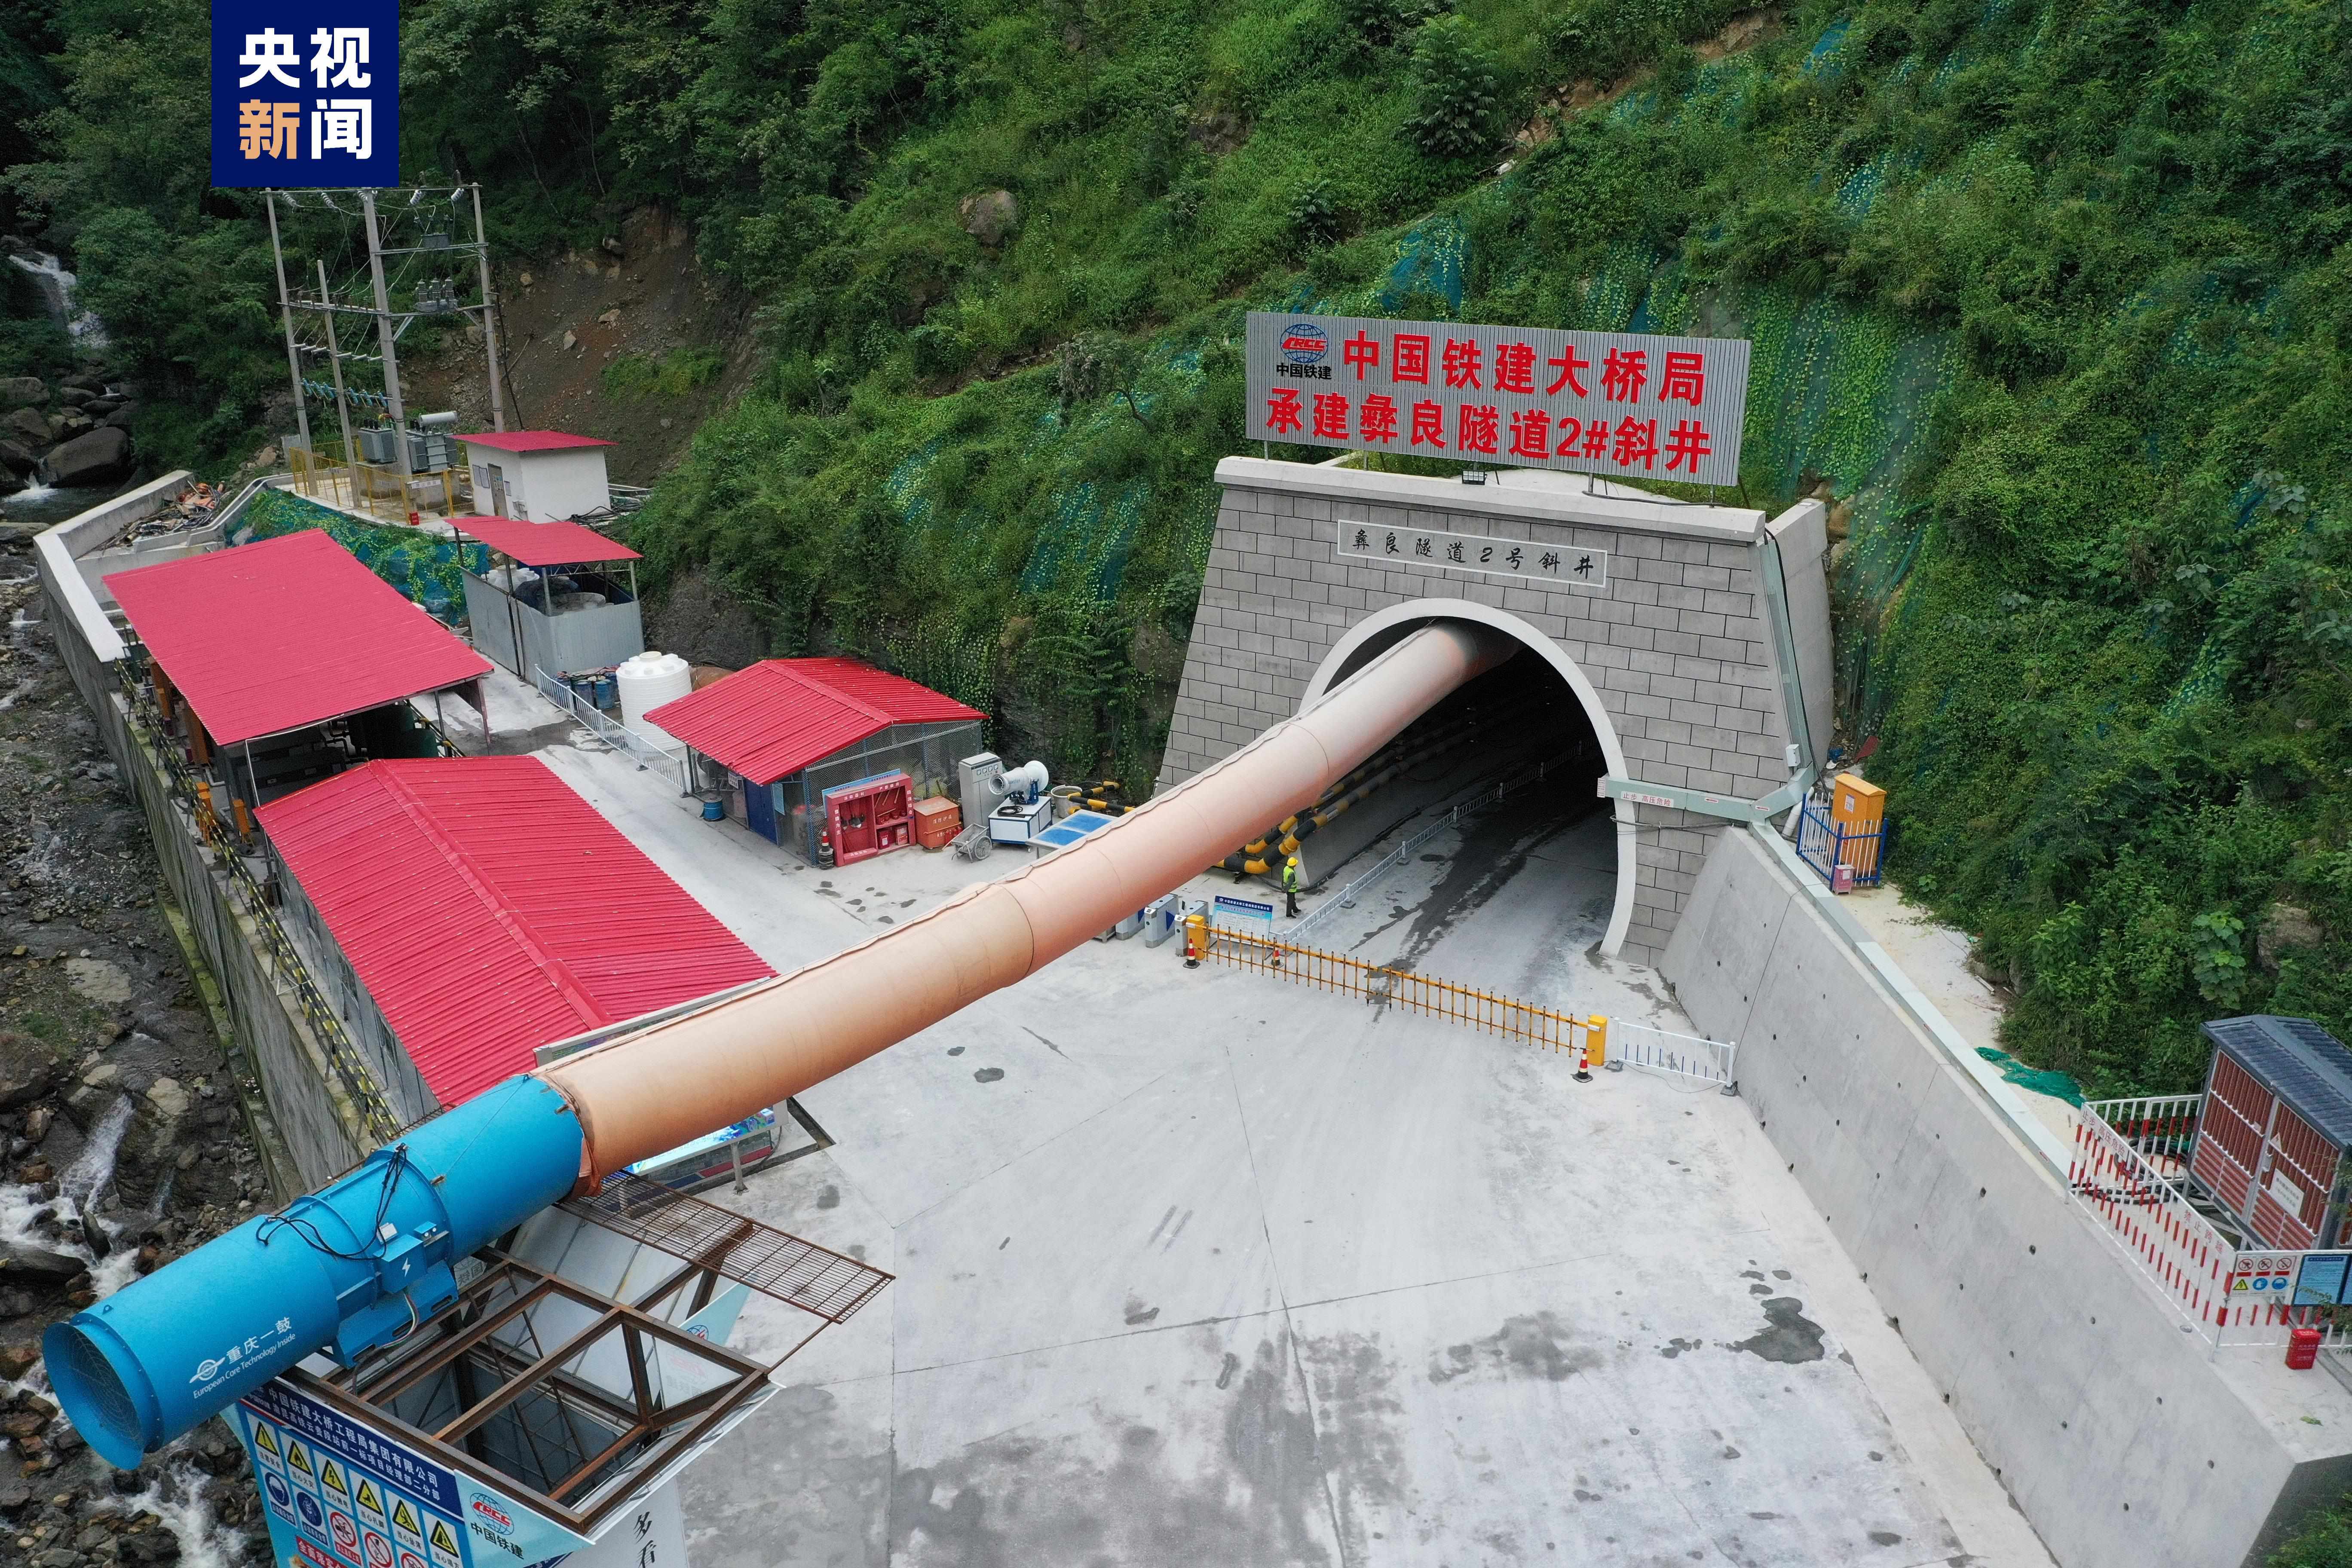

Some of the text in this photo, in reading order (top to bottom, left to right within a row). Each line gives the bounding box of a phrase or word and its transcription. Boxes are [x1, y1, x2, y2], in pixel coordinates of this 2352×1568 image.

[1276, 362, 1332, 380] 中国铁建
[1344, 329, 1704, 407] 中国铁建大桥局
[1267, 387, 1711, 473] 承建彝良隧道2#斜井
[1352, 528, 1593, 579] 彝良隧道2号斜井
[1642, 795, 1671, 806] 高压危险
[2082, 1110, 2096, 1126] 止步
[226, 1317, 292, 1364] 重庆一鼓
[193, 1376, 225, 1399] European
[225, 1366, 241, 1380] Core
[240, 1344, 277, 1370] Technology
[276, 1333, 296, 1348] Inside
[269, 1387, 438, 1488] 中国铁建大桥工程局集团有限公司
[473, 1501, 511, 1527] CRCC
[298, 1540, 343, 1568] 全面落实
[470, 1522, 524, 1560] 中国铁建
